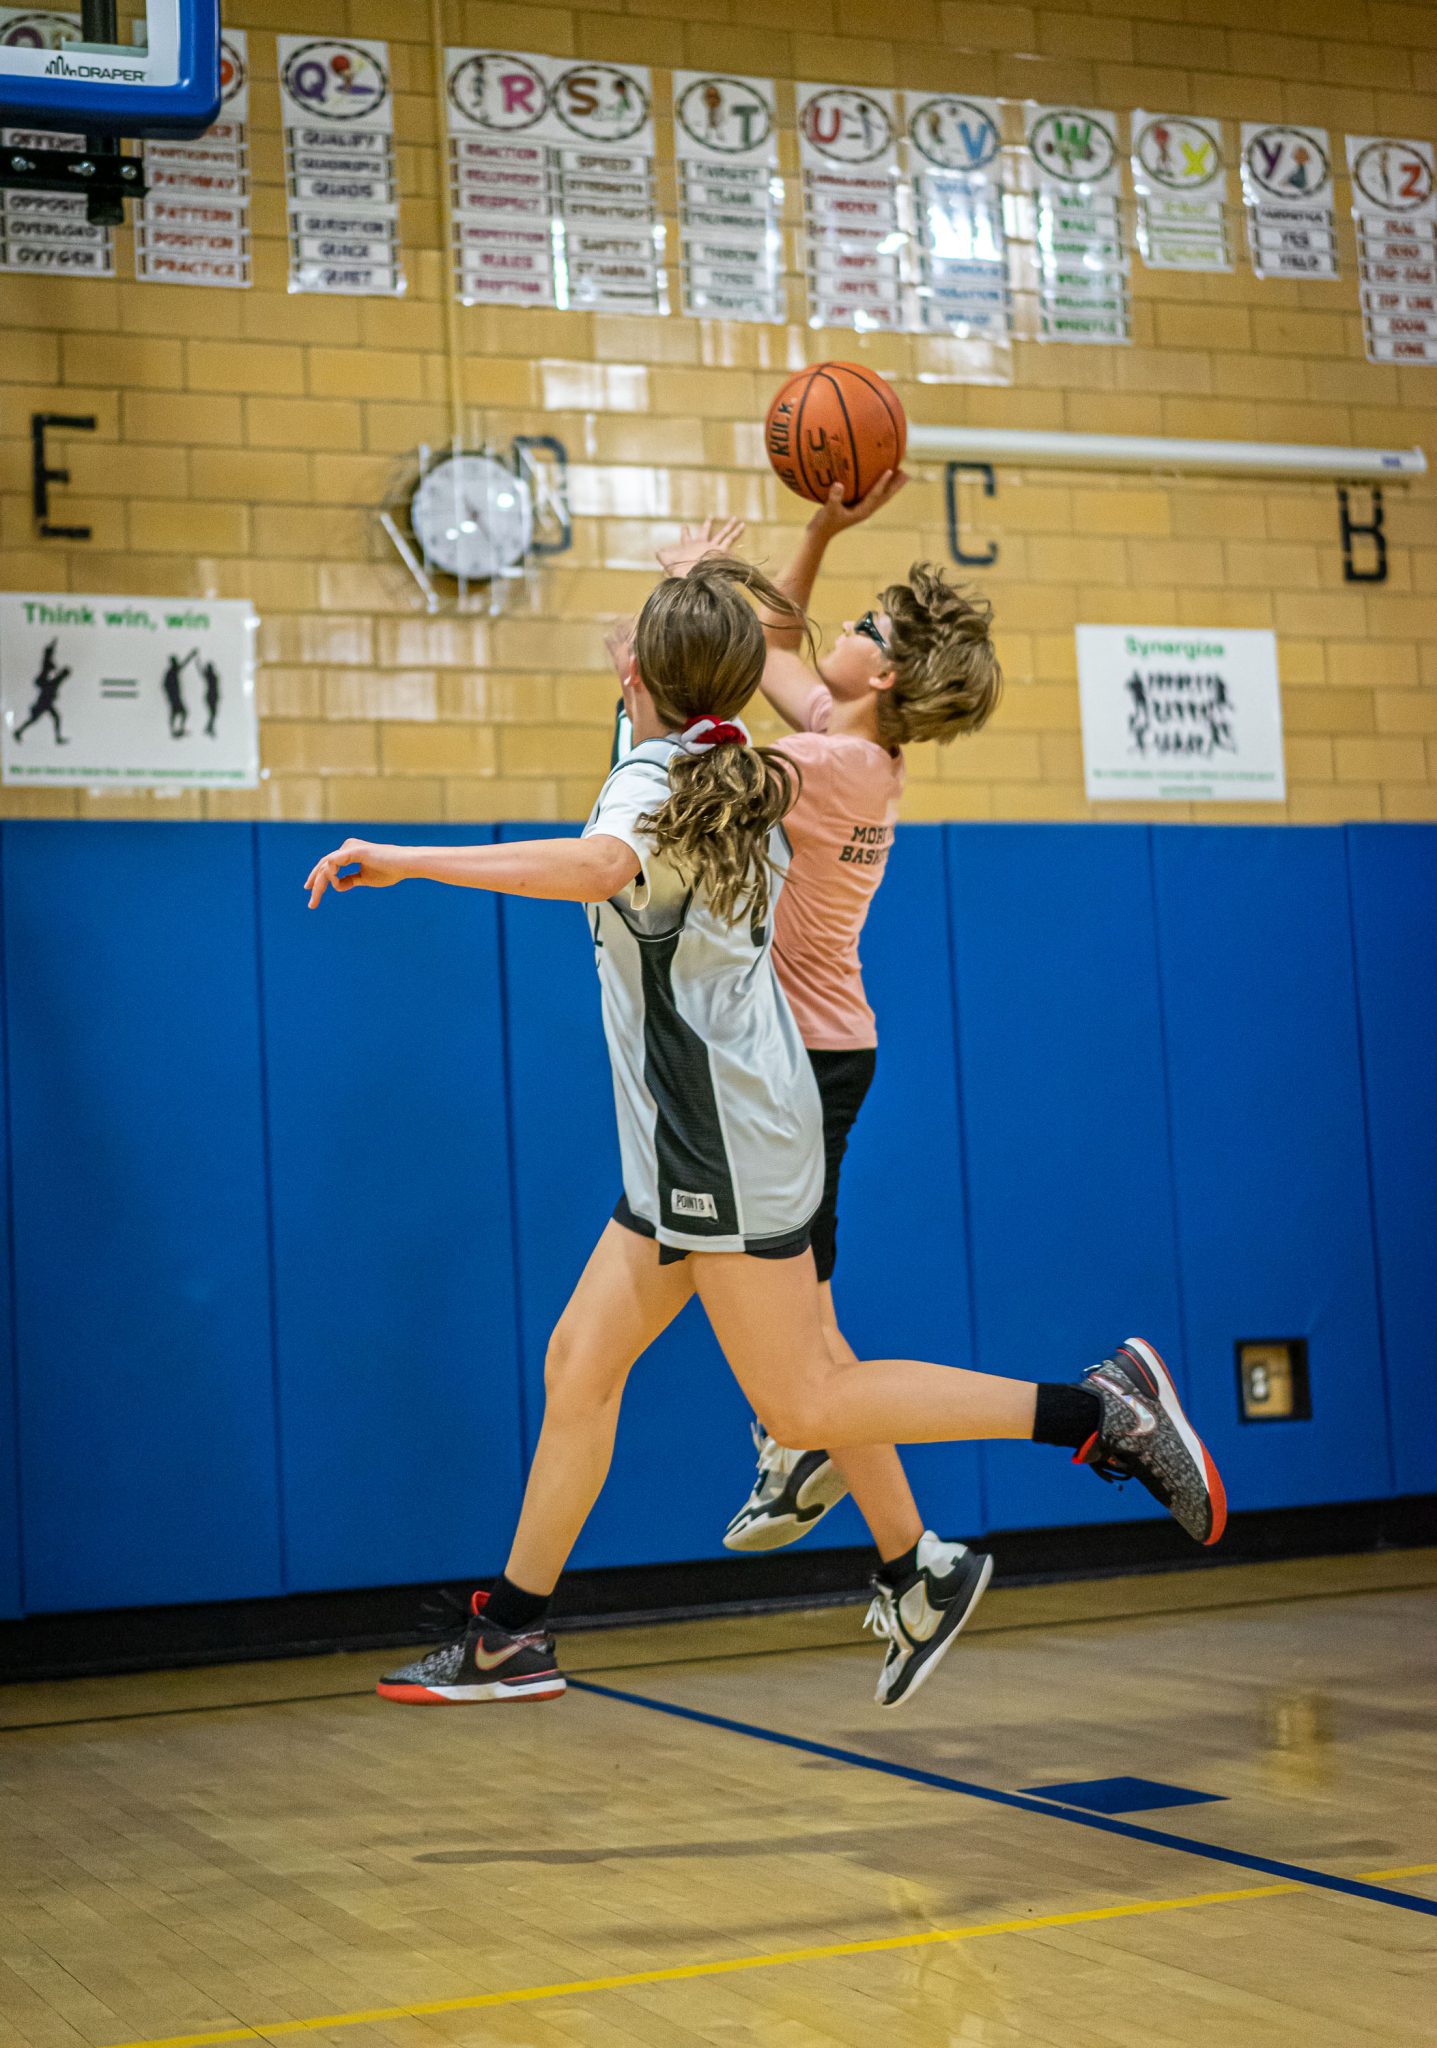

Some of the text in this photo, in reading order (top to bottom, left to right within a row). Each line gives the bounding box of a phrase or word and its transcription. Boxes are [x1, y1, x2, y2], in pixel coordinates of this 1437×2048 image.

[78, 66, 145, 81] DRAPER
[294, 62, 327, 103] Q
[501, 74, 535, 114] R
[566, 77, 599, 116] S
[731, 104, 759, 149] T
[813, 106, 841, 144] U
[958, 121, 988, 161] V
[1181, 142, 1211, 176] X
[1400, 163, 1423, 197] Z
[10, 195, 86, 212] OPPOSIT
[32, 413, 96, 540] E
[946, 461, 997, 567] C
[1337, 481, 1389, 583] B
[22, 602, 211, 631] Think win, win
